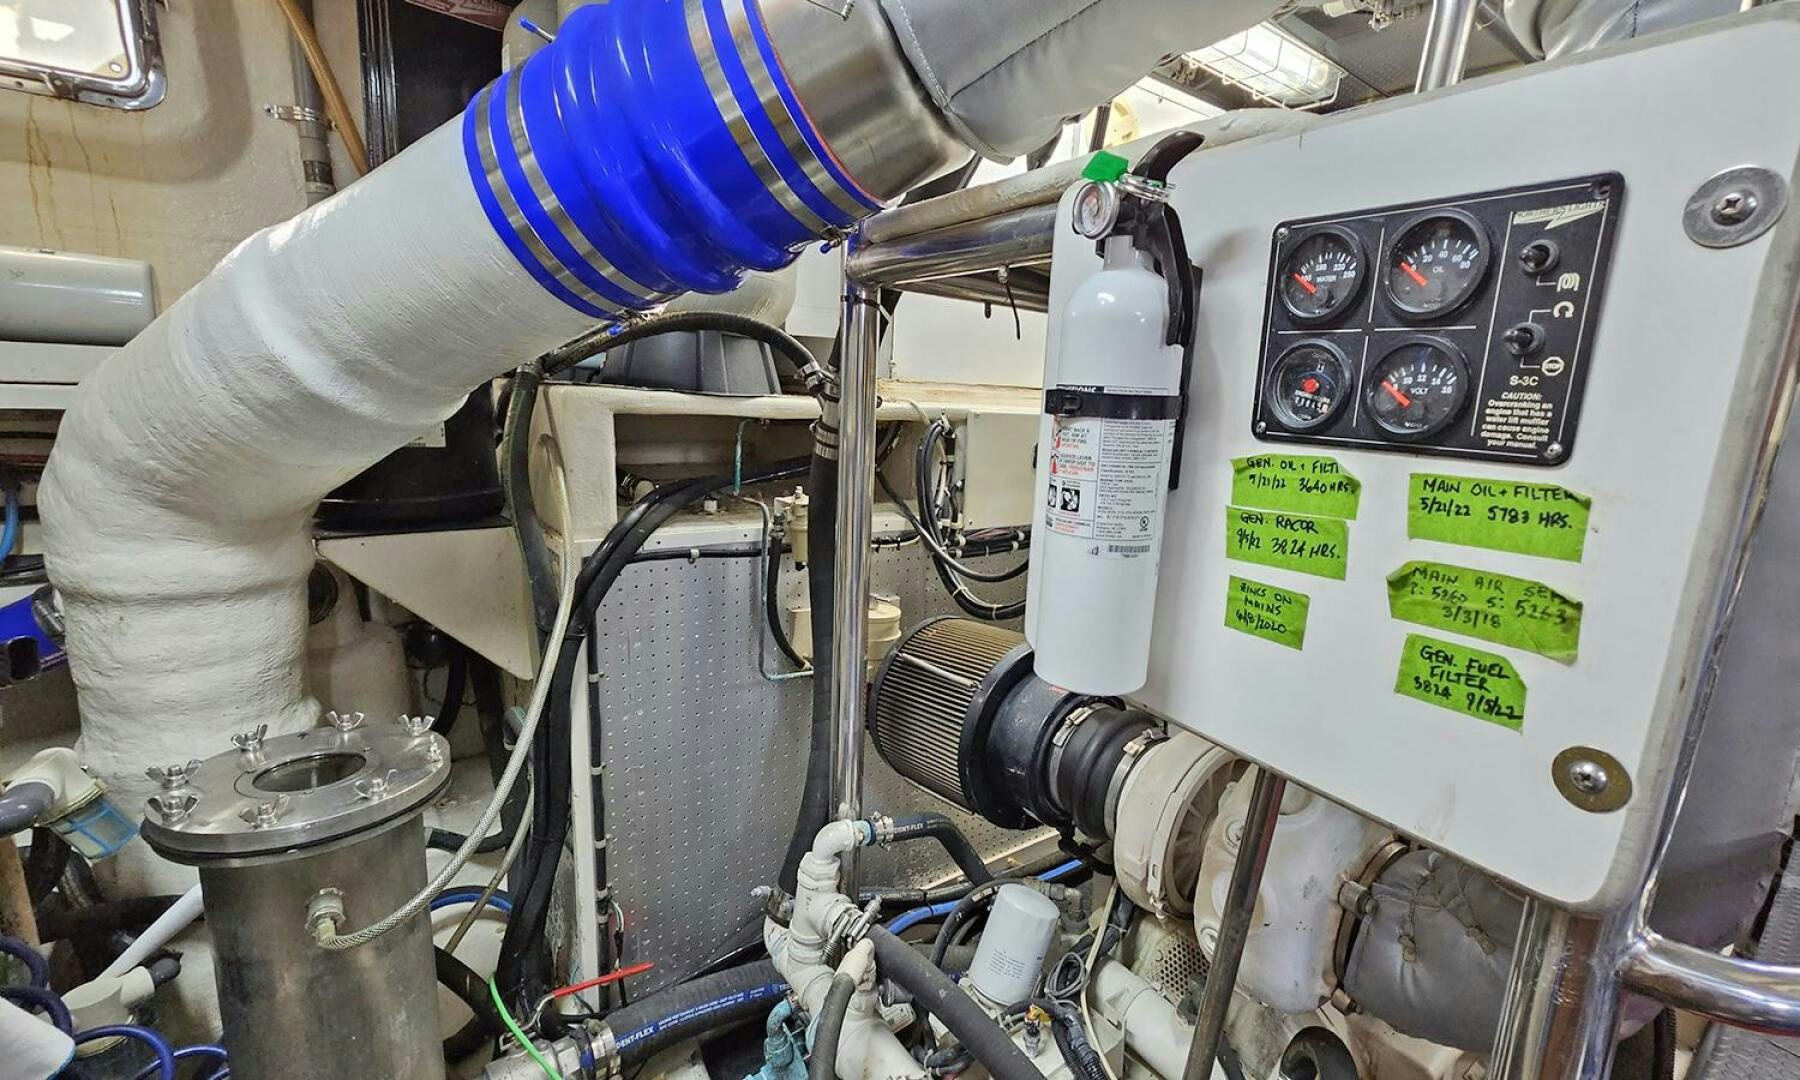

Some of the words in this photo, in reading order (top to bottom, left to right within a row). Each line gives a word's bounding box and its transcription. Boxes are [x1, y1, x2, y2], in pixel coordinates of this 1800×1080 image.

[1422, 254, 1433, 264] 20
[1438, 250, 1448, 258] 40
[1452, 254, 1463, 263] 60
[1416, 374, 1428, 382] 12
[1509, 375, 1540, 386] S-3C
[1410, 387, 1429, 396] VOLT
[1501, 391, 1542, 400] CAUTION:
[1488, 399, 1541, 410] Overcranking
[1485, 408, 1512, 416] engine
[1512, 408, 1530, 416] that
[1530, 409, 1545, 417] has
[1480, 430, 1513, 440] damage.
[1516, 432, 1548, 442] Consult
[1522, 426, 1550, 434] engine
[1247, 458, 1274, 469] GEN.
[1422, 478, 1460, 494] MAIN
[1470, 483, 1496, 498] OIL
[1420, 496, 1472, 516] 5/21/22
[1487, 505, 1530, 524] 5783
[1538, 512, 1573, 528] HRS.
[1240, 512, 1269, 526] GEN.
[1276, 516, 1318, 534] RACOR
[1271, 538, 1307, 558] 3824
[1309, 544, 1340, 559] HRS.
[1412, 566, 1459, 584] MAIN
[1474, 576, 1504, 594] AIR
[1240, 582, 1268, 597] ZINCS
[1274, 594, 1292, 605] ON
[1244, 595, 1282, 616] MAINS
[1442, 604, 1501, 629] 3/3/18
[1515, 599, 1568, 626] 5263
[1420, 645, 1458, 667] GEN.
[1466, 658, 1511, 679] FUEL
[1430, 665, 1492, 694] FILTER
